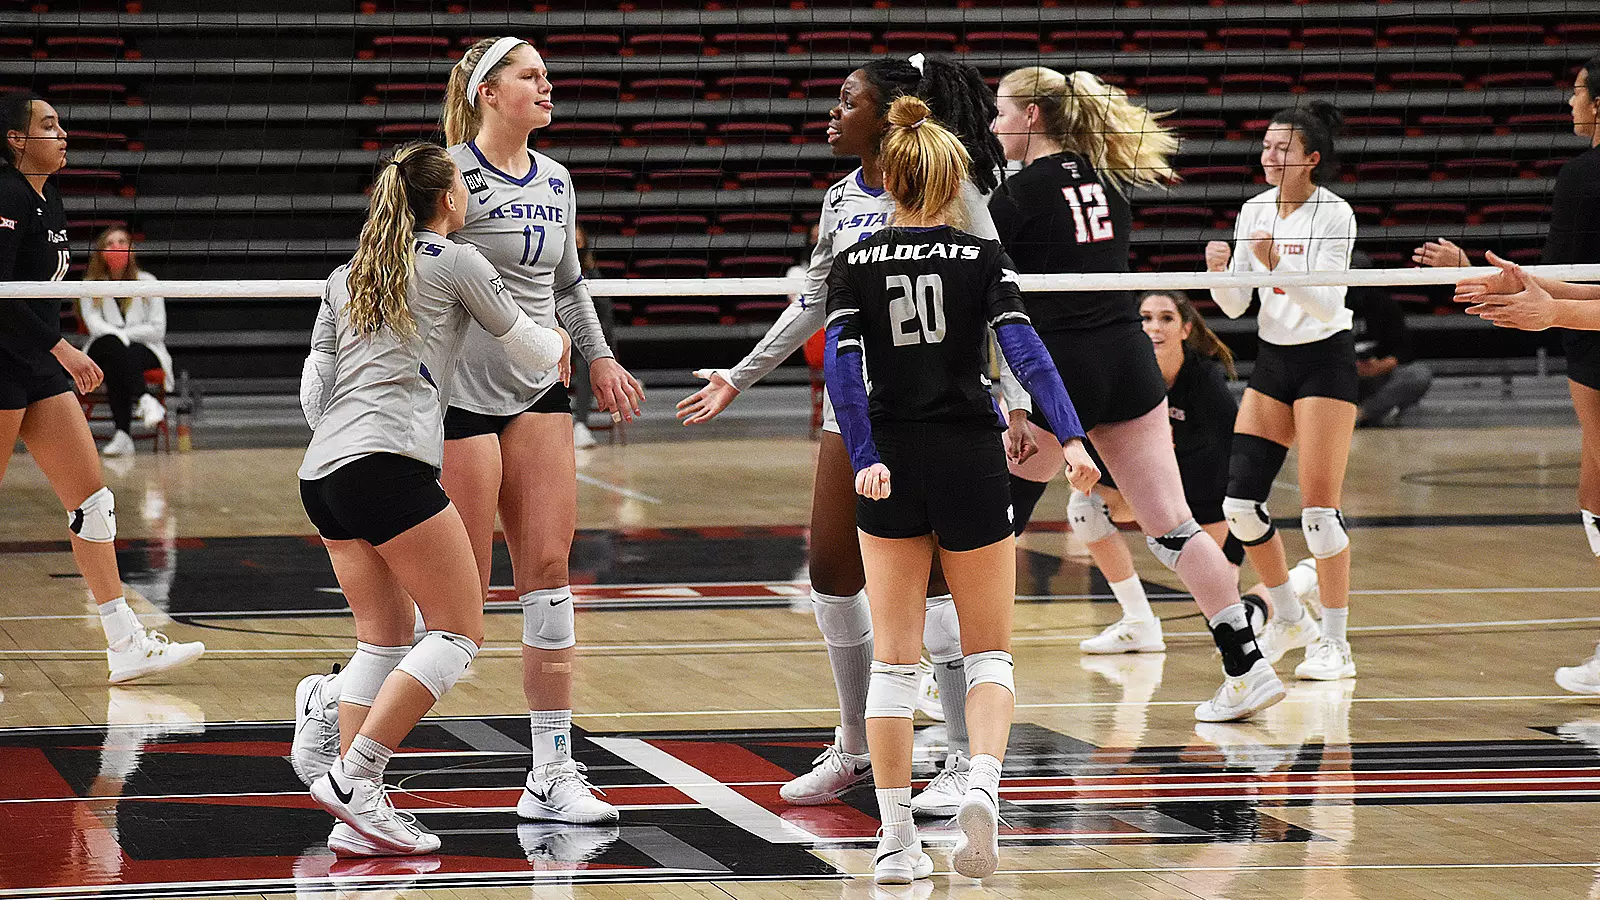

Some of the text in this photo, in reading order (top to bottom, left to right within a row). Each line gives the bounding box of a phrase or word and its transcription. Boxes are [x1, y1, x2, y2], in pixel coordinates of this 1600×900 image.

[465, 171, 486, 190] BLM
[488, 204, 563, 223] K-STATE
[834, 212, 896, 231] K-STA
[1061, 183, 1114, 244] 12
[519, 225, 546, 267] 17
[847, 243, 981, 266] WILDCATS
[885, 273, 947, 347] 20
